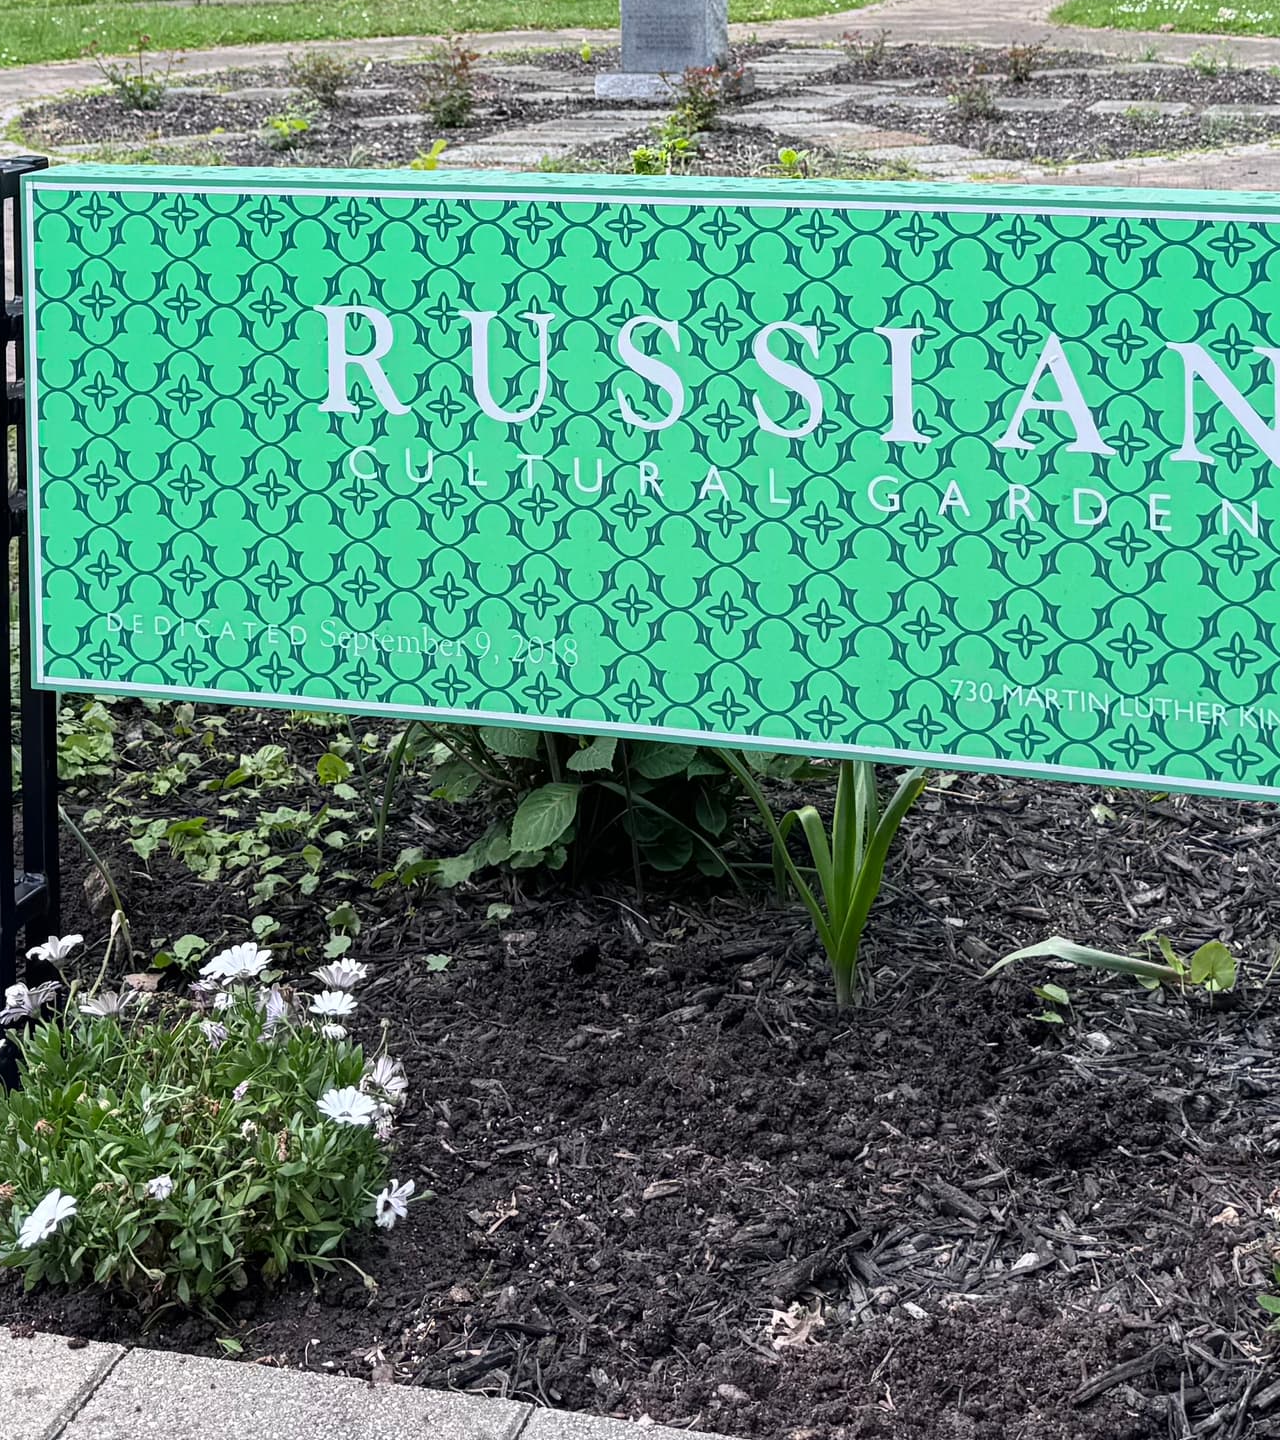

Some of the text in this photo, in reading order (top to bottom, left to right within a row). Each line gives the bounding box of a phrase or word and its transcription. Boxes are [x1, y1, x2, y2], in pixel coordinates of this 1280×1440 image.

[348, 445, 1260, 539] CULTURAL GARDEN
[107, 612, 579, 667] DEDICATED September 9, 2018
[949, 678, 994, 704] 730
[1003, 684, 1109, 715] MARTIN
[1120, 694, 1230, 727] LUTHER
